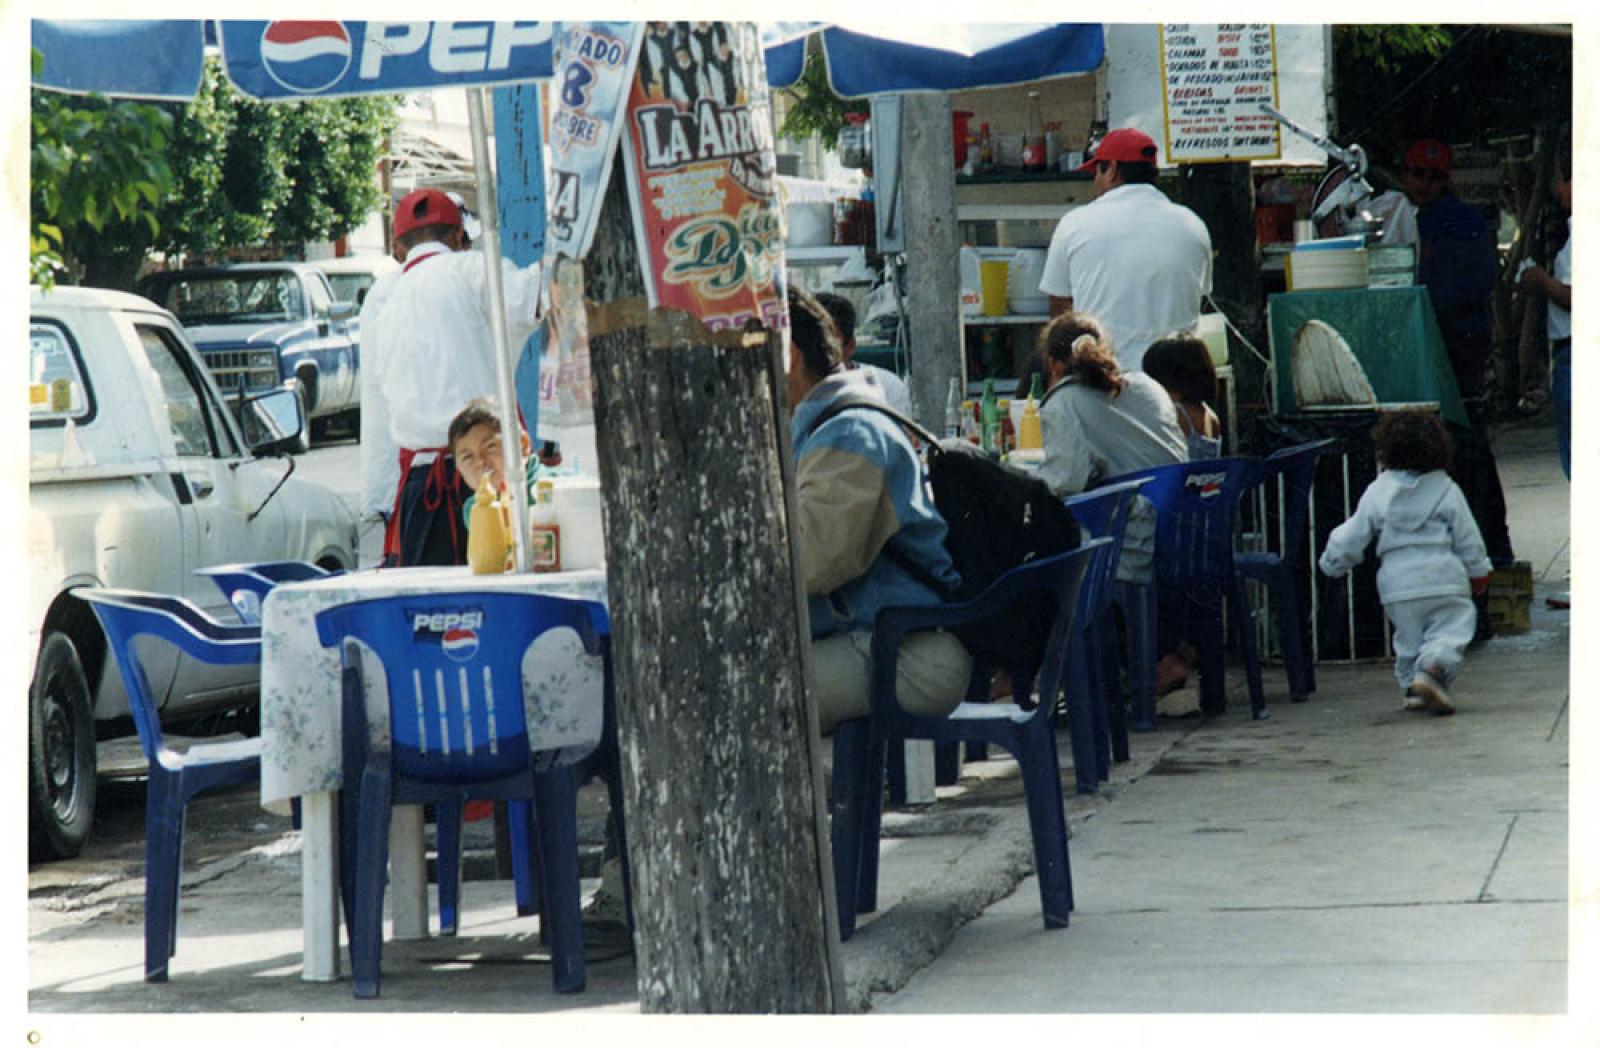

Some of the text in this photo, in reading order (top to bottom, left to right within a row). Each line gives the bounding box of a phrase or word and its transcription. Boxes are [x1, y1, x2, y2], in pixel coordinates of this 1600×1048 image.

[573, 32, 622, 65] ADO
[641, 103, 692, 167] LA
[1185, 472, 1226, 487] PEPSI
[413, 610, 483, 632] PEPSI
